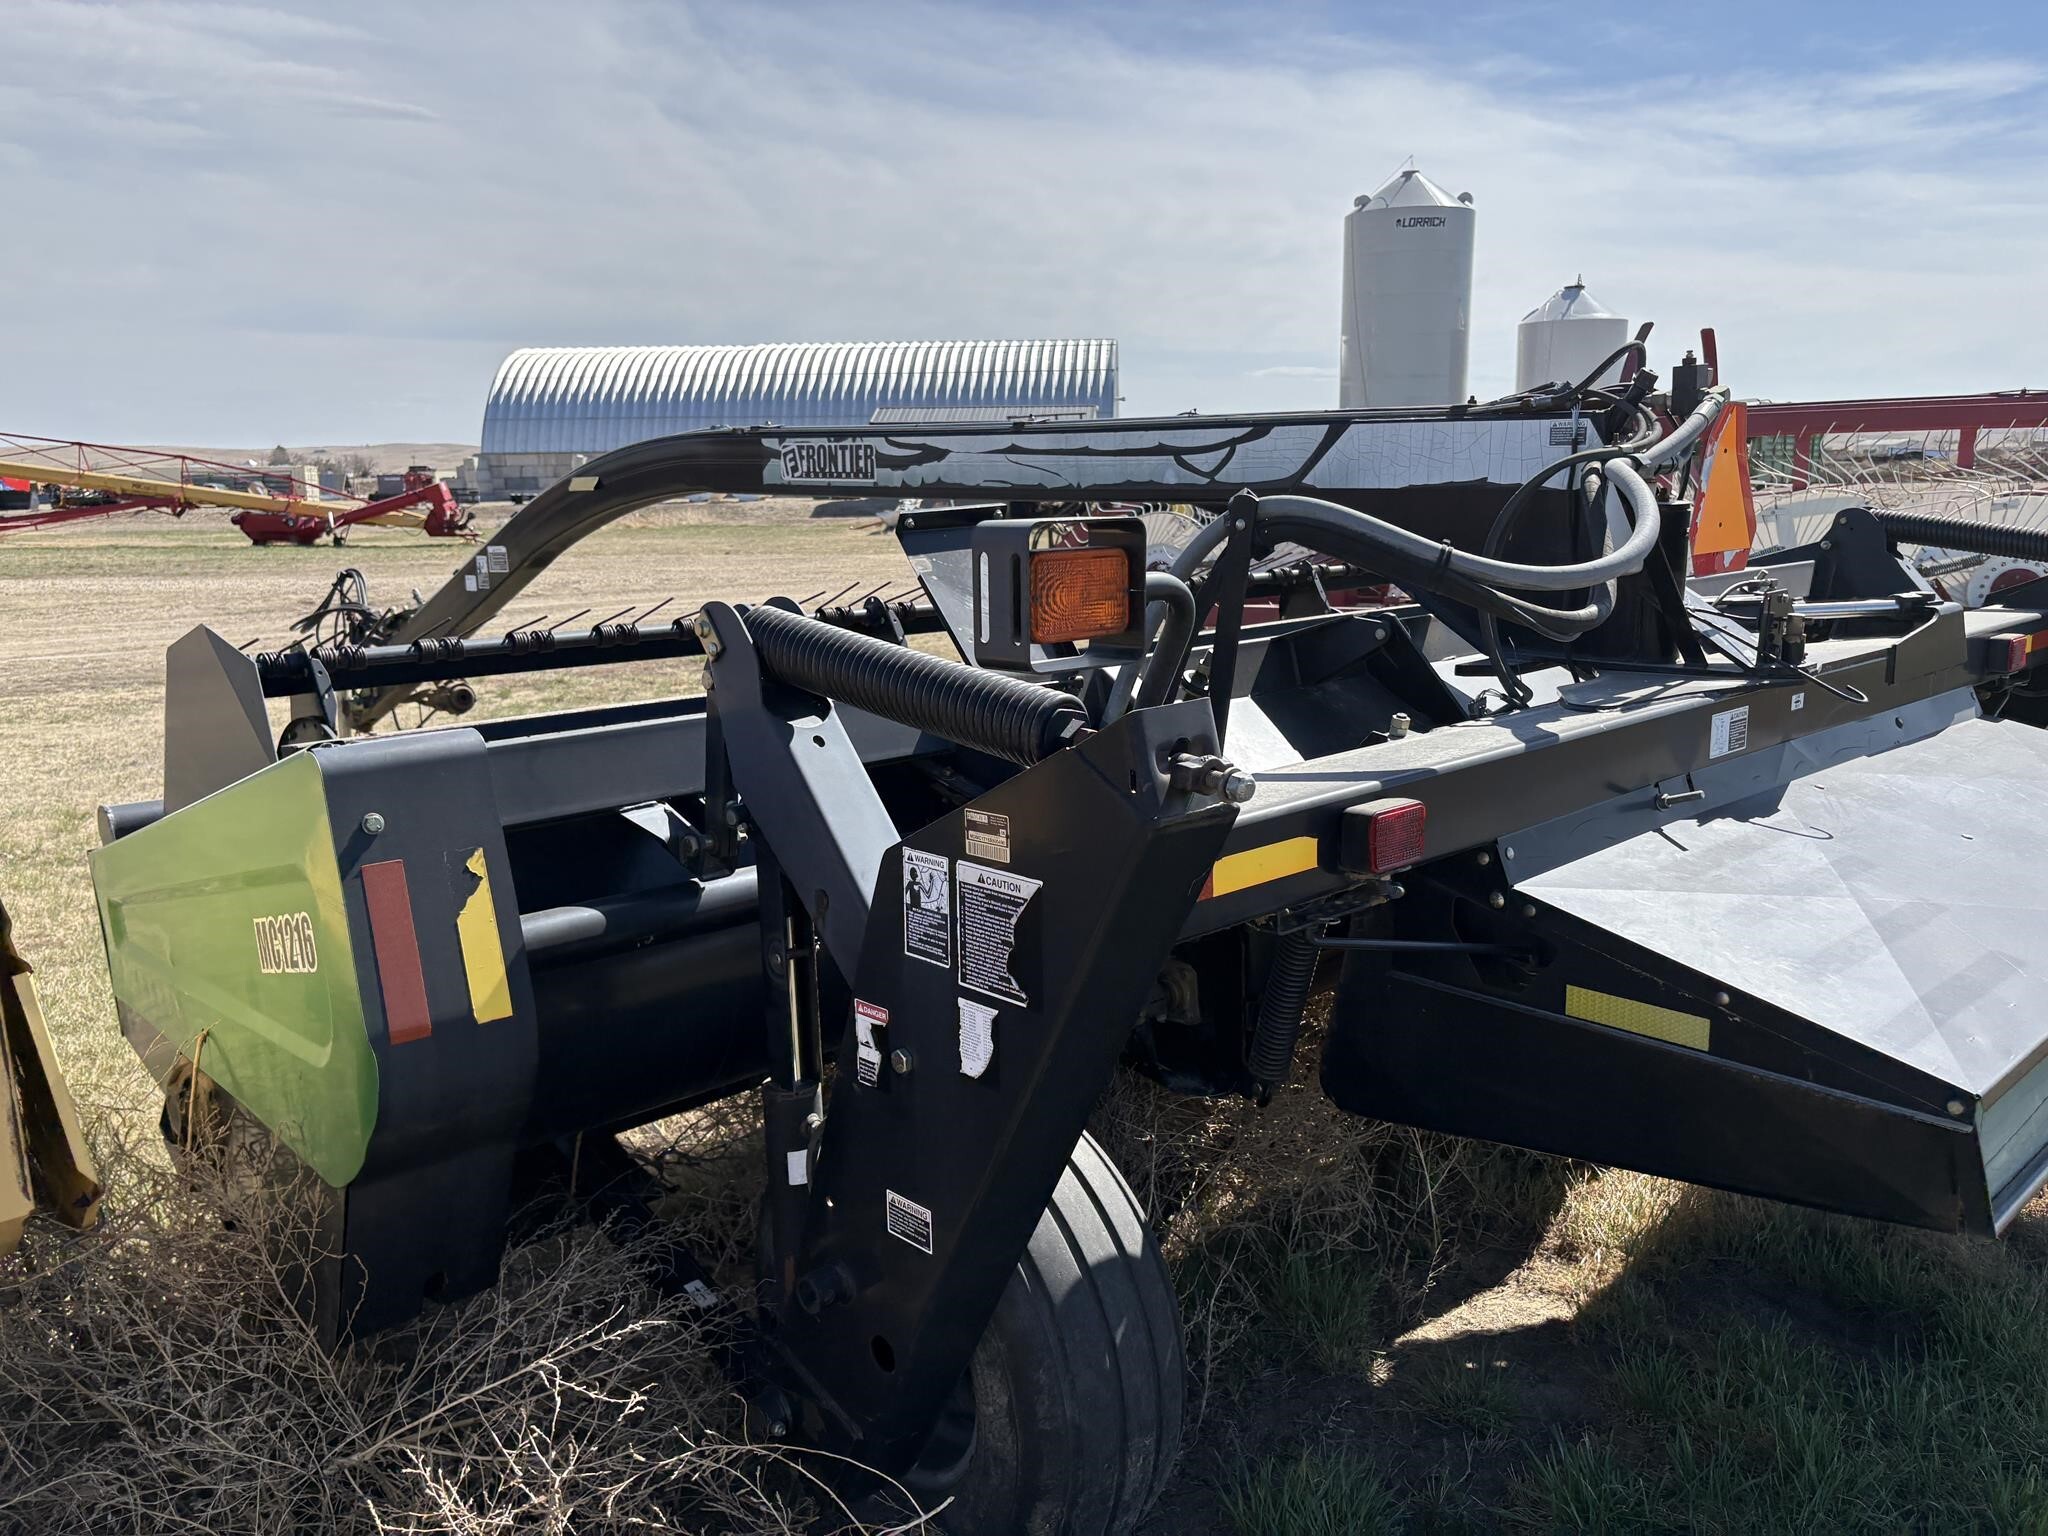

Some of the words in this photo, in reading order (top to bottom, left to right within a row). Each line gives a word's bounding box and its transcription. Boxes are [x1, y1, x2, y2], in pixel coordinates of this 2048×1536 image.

[1402, 216, 1447, 228] LORRICH
[800, 444, 875, 473] FRONTIER
[914, 855, 945, 869] WARNING
[985, 876, 1021, 893] CAUTION
[253, 911, 318, 973] MC1216
[863, 1006, 887, 1020] DANGER
[896, 1198, 928, 1220] WARNING
